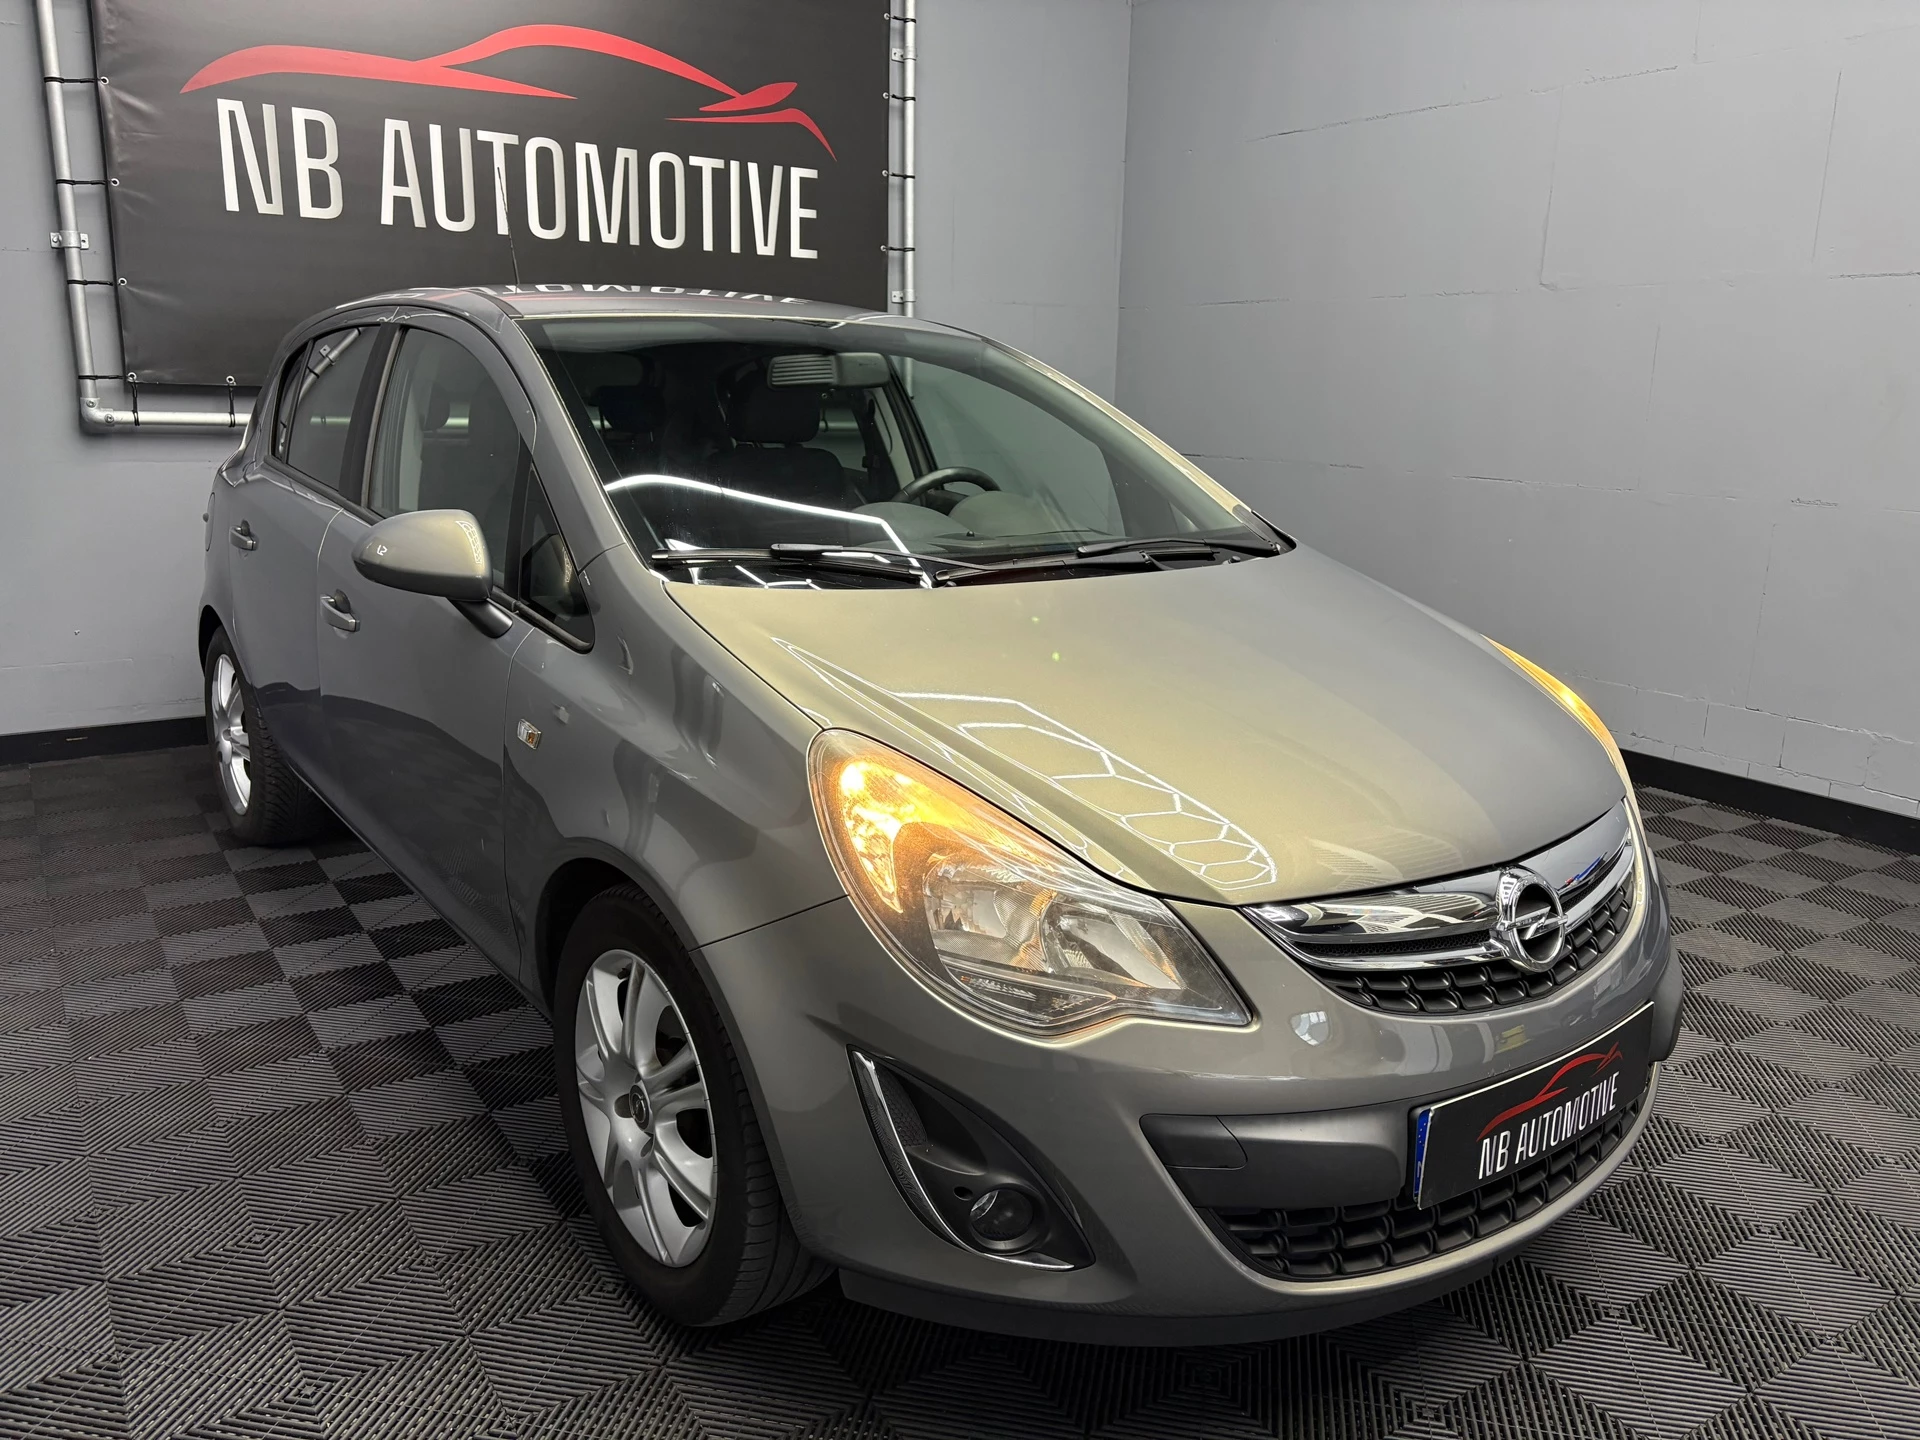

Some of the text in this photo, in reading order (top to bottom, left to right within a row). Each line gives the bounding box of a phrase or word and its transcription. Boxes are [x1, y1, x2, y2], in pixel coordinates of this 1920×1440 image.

[217, 98, 819, 260] NB AUTOMOTIVE
[1478, 1071, 1620, 1180] NB AUTOMOTIVE
